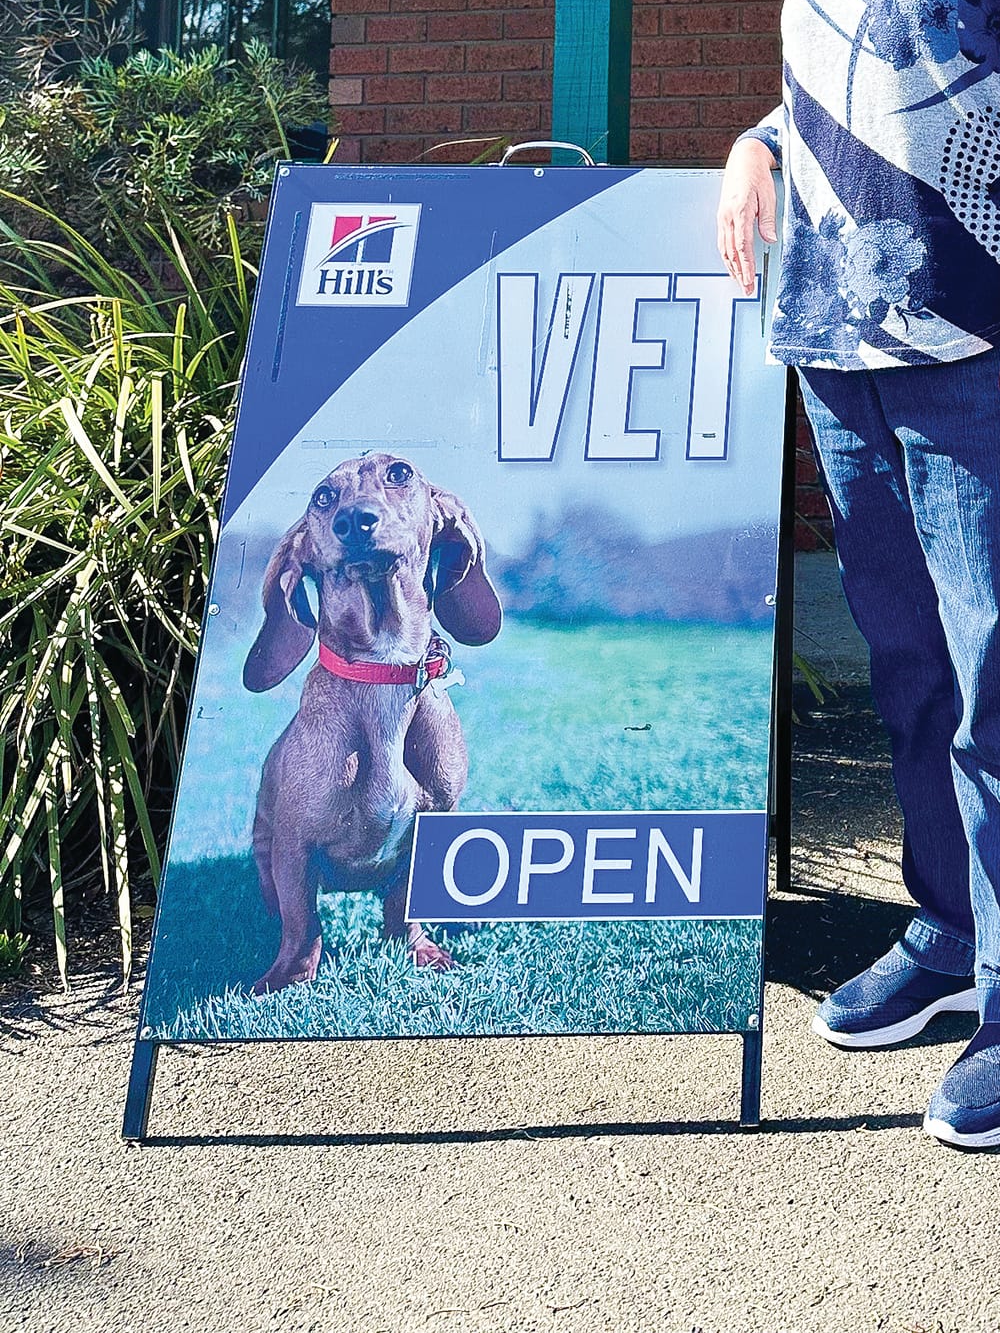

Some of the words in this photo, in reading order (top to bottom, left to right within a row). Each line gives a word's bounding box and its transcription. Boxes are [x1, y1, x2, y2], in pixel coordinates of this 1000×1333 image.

[316, 269, 394, 295] Hill's
[497, 273, 761, 462] VET
[443, 828, 703, 906] OPEN
